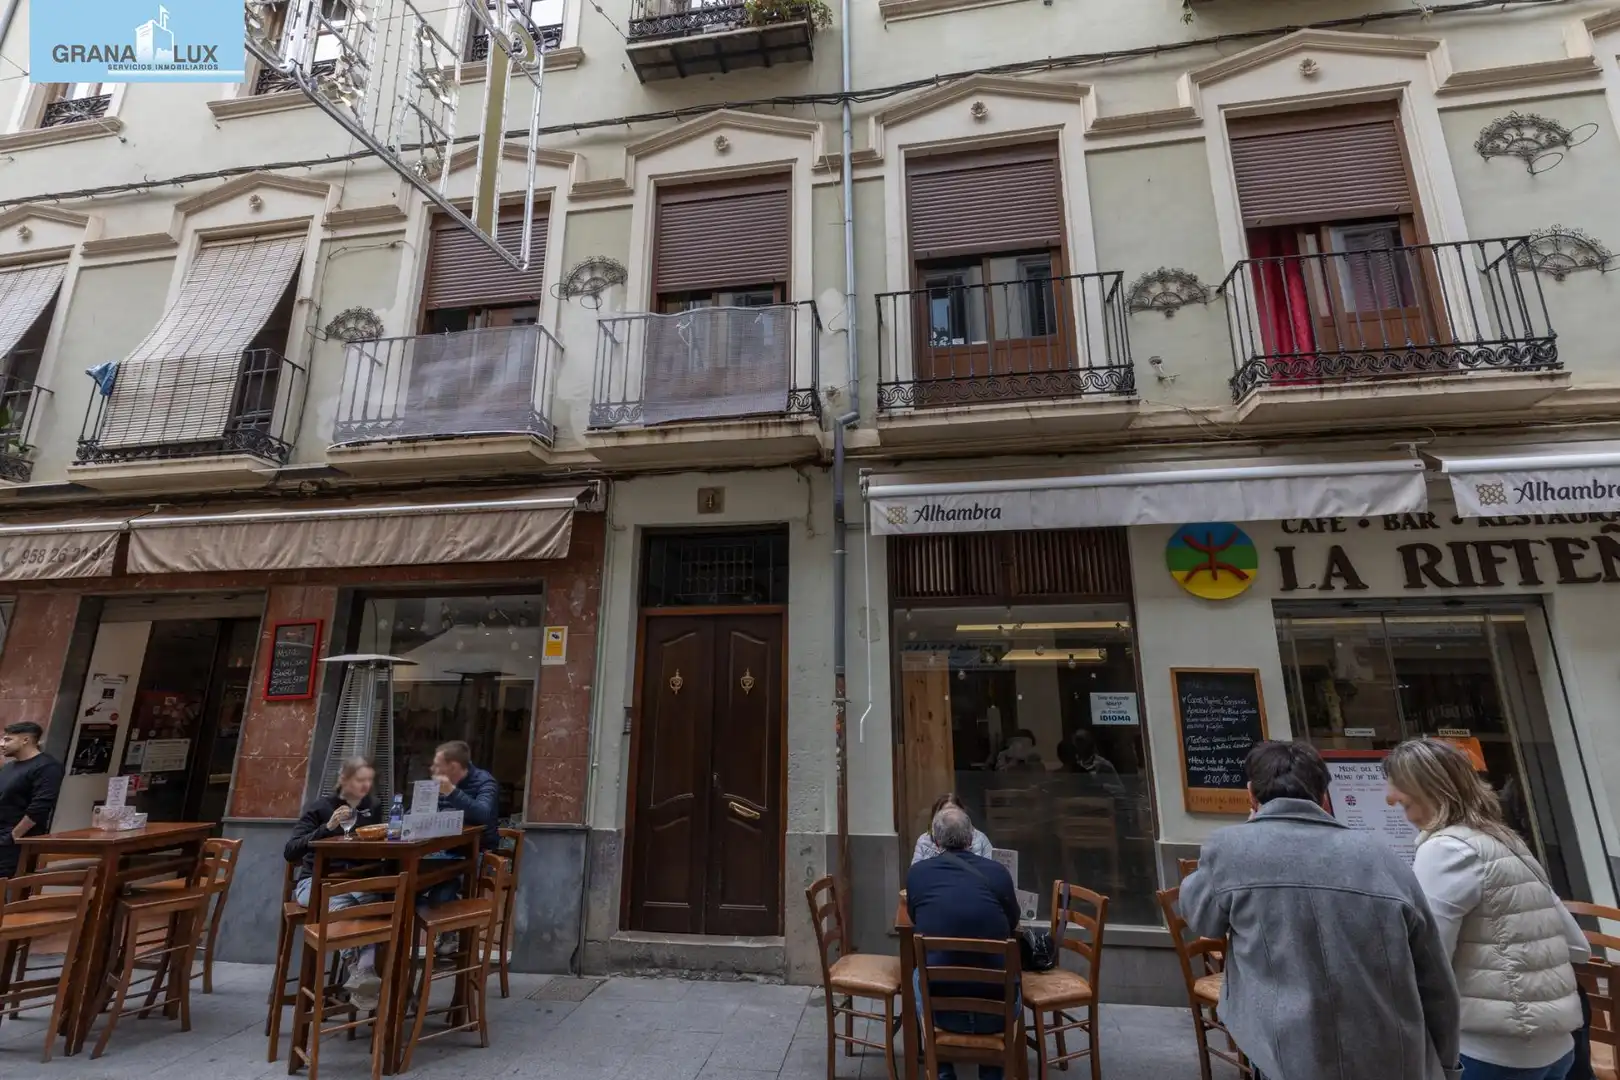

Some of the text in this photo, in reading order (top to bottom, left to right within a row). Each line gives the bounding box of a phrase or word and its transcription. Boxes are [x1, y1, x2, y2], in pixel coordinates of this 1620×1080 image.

[1513, 477, 1620, 505] Alhambr
[913, 502, 1002, 525] Alhambra
[1383, 511, 1441, 531] BAR
[21, 548, 46, 565] 958
[48, 547, 68, 564] 26
[1275, 545, 1369, 592] LA
